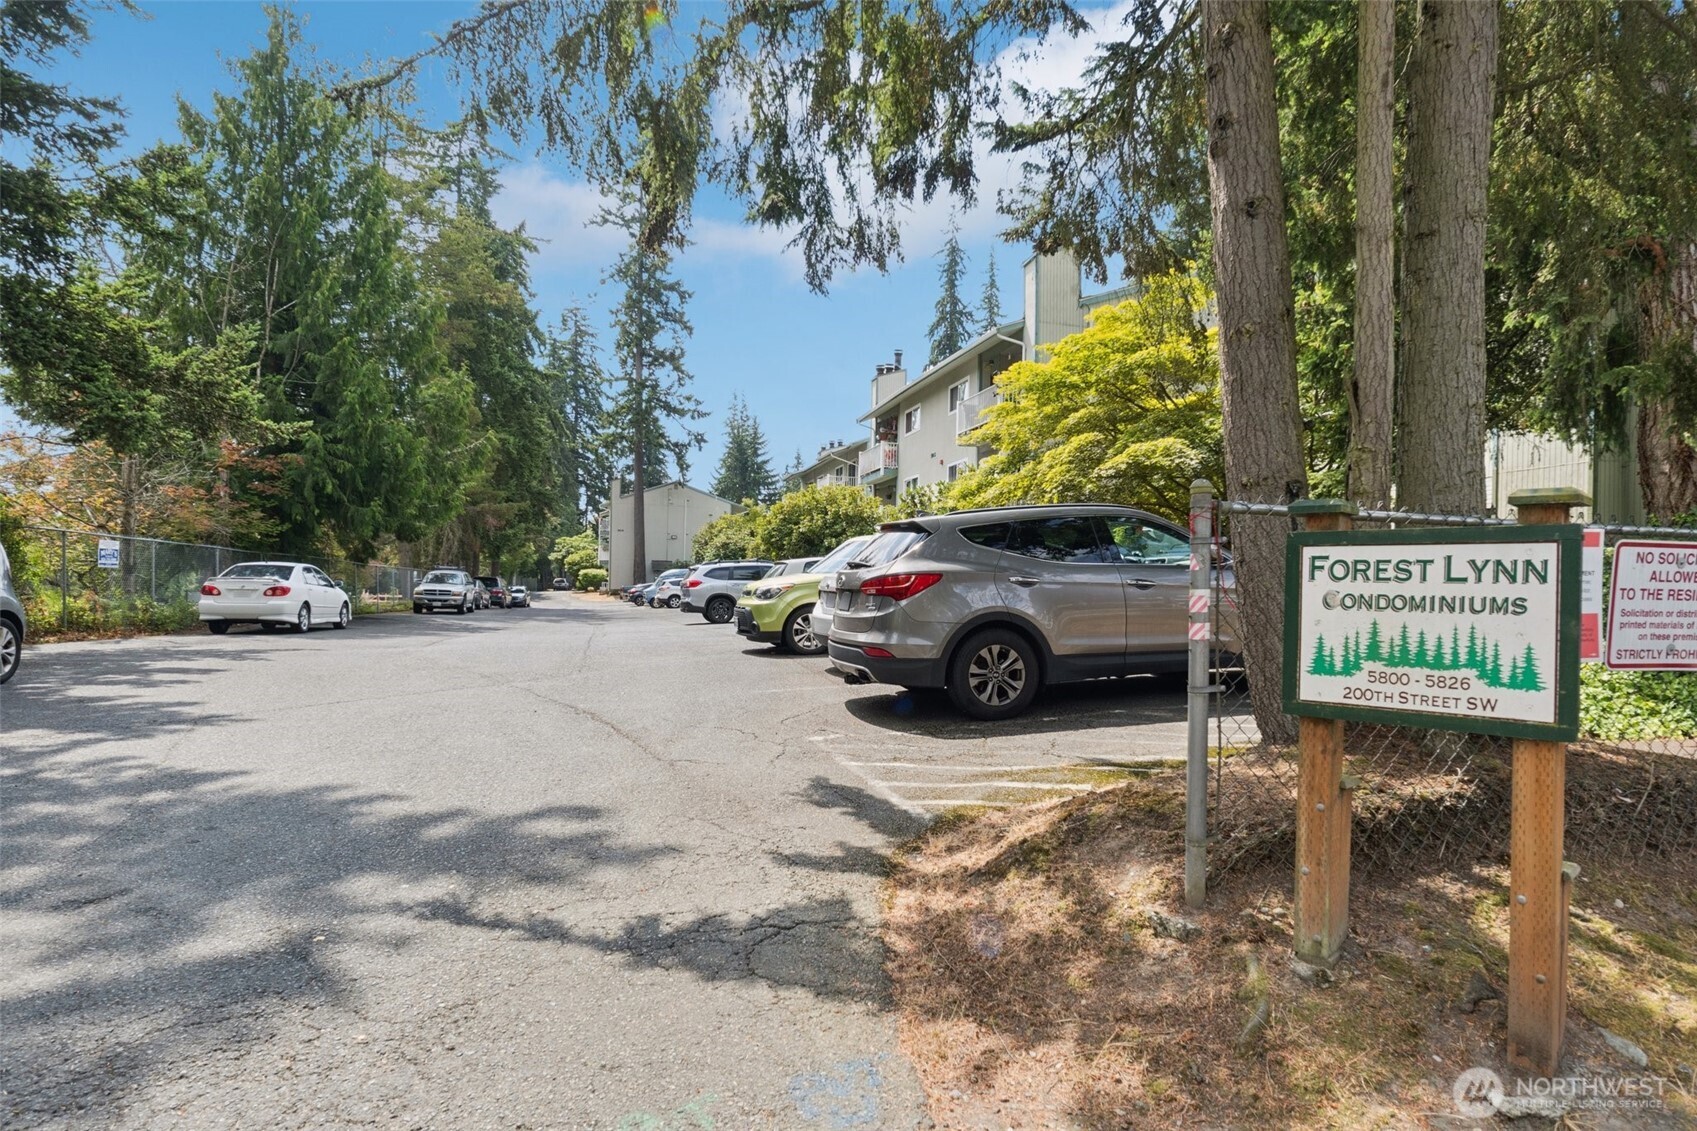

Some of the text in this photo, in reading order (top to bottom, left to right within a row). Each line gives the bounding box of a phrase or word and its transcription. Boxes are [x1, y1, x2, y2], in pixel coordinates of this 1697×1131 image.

[1636, 551, 1655, 564] NO
[1308, 555, 1549, 585] FOREST LYNN
[1620, 588, 1697, 601] TO THE RESI
[1322, 590, 1528, 616] CONDOMINIUMS
[1620, 608, 1664, 618] Solicitation
[1665, 610, 1674, 618] or
[1619, 621, 1695, 630] printed materials of
[1637, 633, 1648, 641] on
[1650, 632, 1671, 641] these
[1616, 648, 1664, 660] STRICTLY
[1367, 671, 1409, 686] 5800
[1425, 674, 1471, 691] 5826
[1343, 686, 1499, 712] 200TH STREET SW
